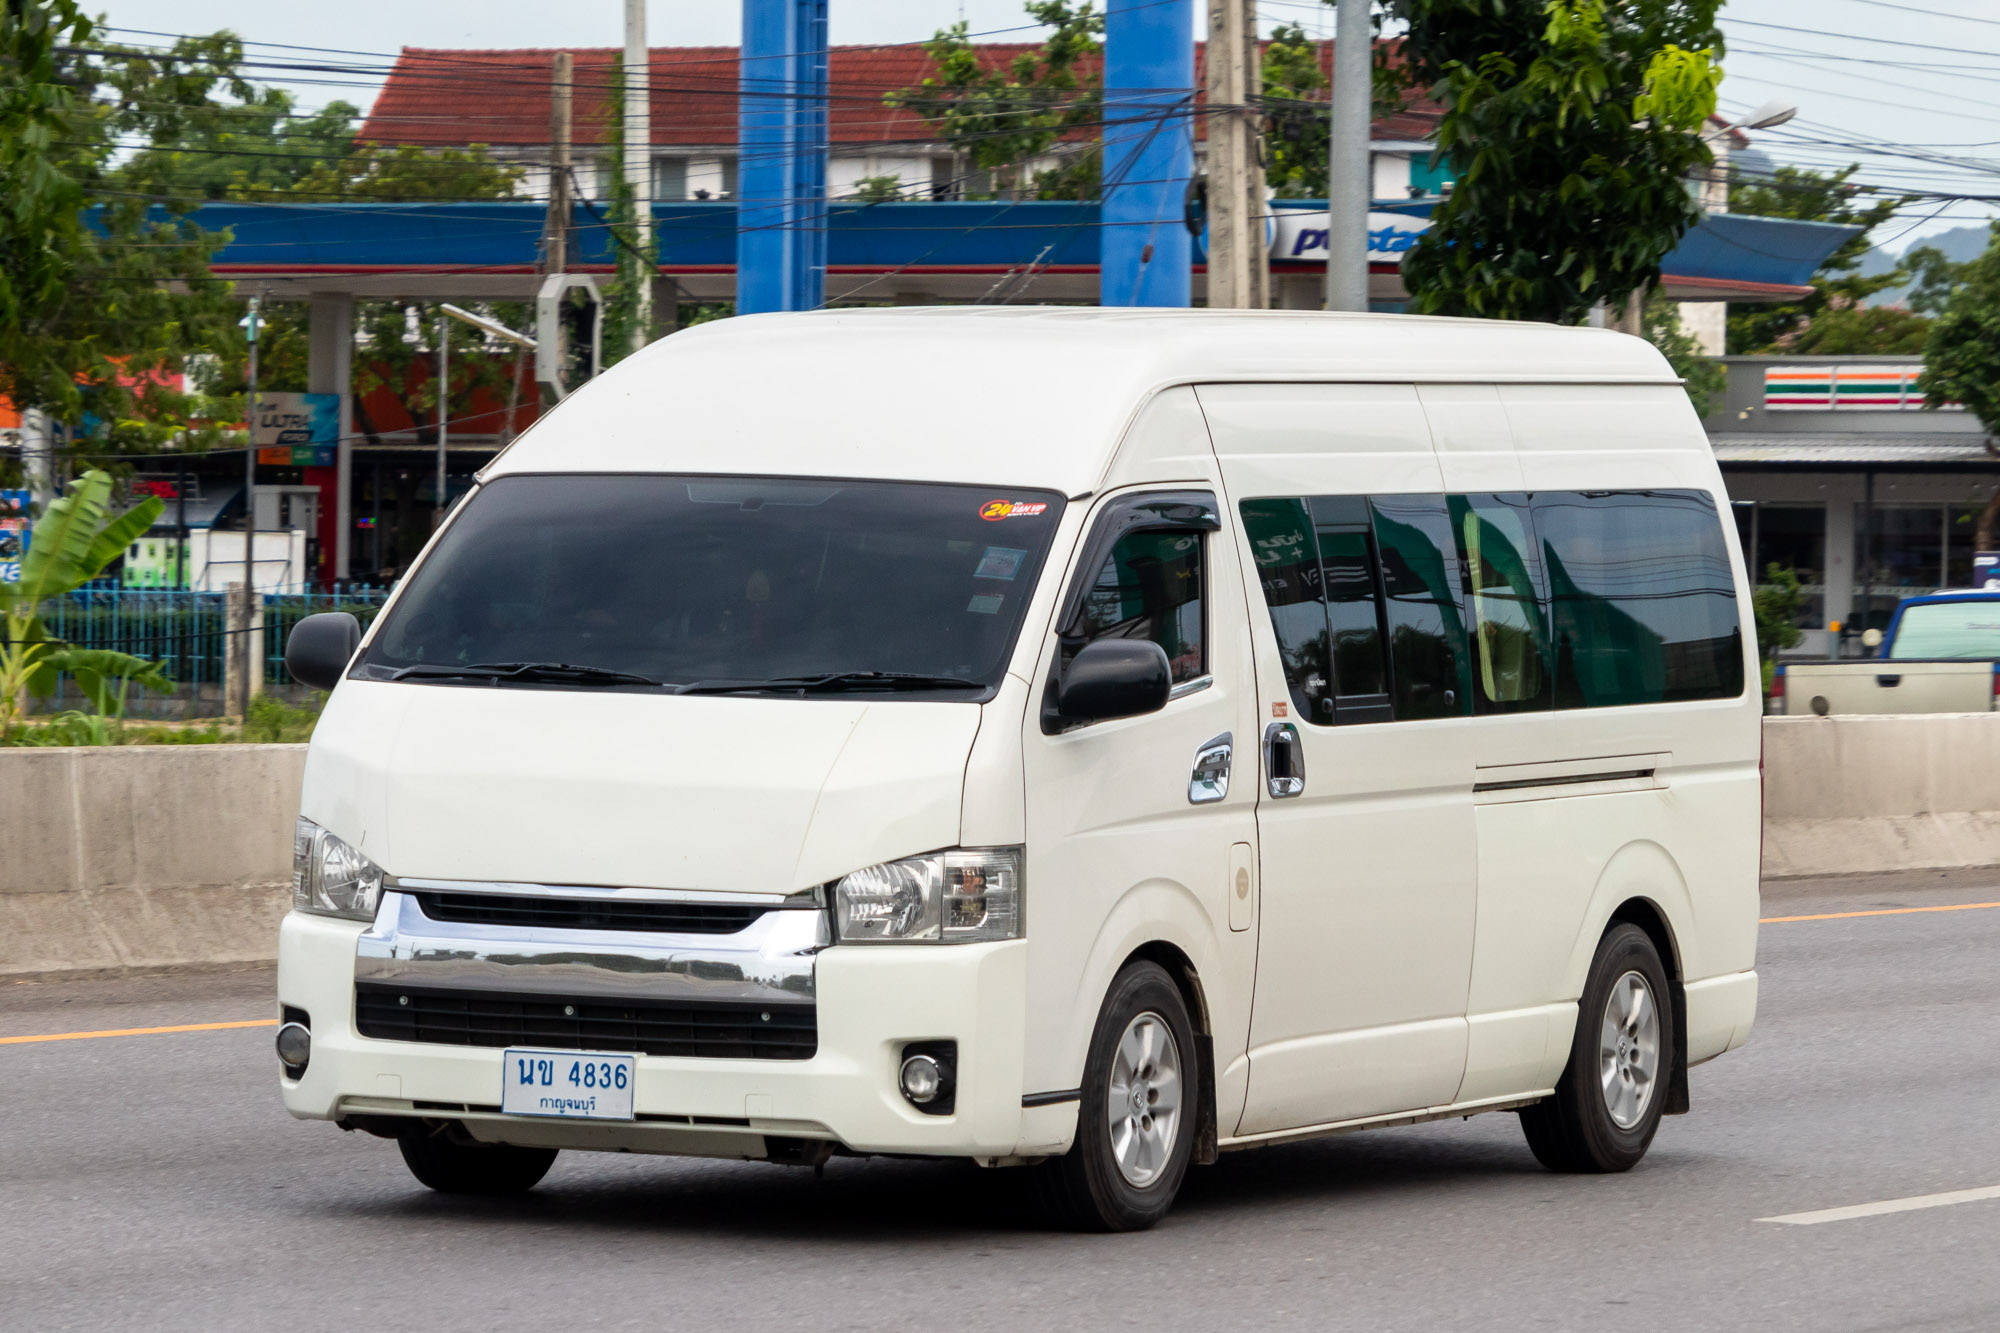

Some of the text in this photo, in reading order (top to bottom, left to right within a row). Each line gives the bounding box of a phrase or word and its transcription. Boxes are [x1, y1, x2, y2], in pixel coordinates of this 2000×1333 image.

[984, 503, 1014, 517] 24
[1011, 505, 1030, 513] VAN
[518, 1058, 628, 1090] นข 4836
[540, 1096, 597, 1115] กาญจนบุรี
